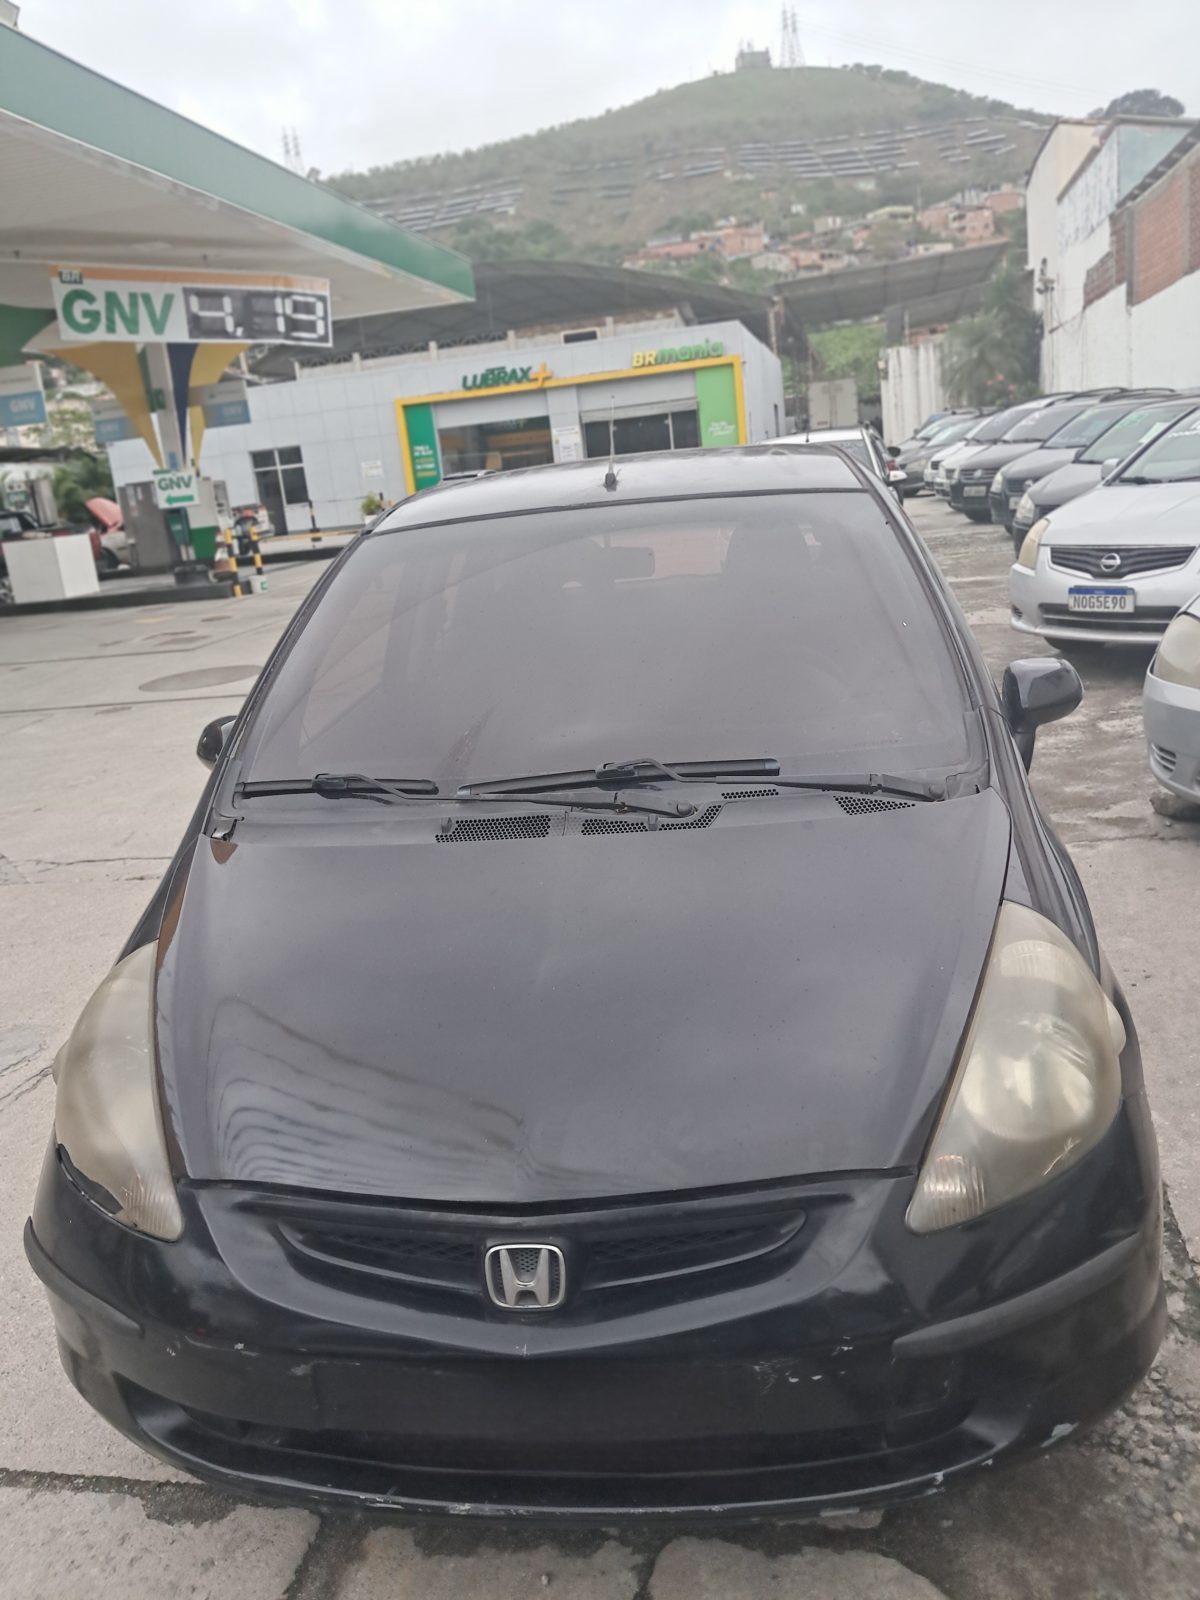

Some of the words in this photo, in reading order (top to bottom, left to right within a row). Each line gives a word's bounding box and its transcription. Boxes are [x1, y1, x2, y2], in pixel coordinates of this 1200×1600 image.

[62, 289, 174, 335] GNV
[189, 294, 325, 339] 4.19
[632, 337, 723, 368] BRmania
[158, 475, 192, 491] GNV
